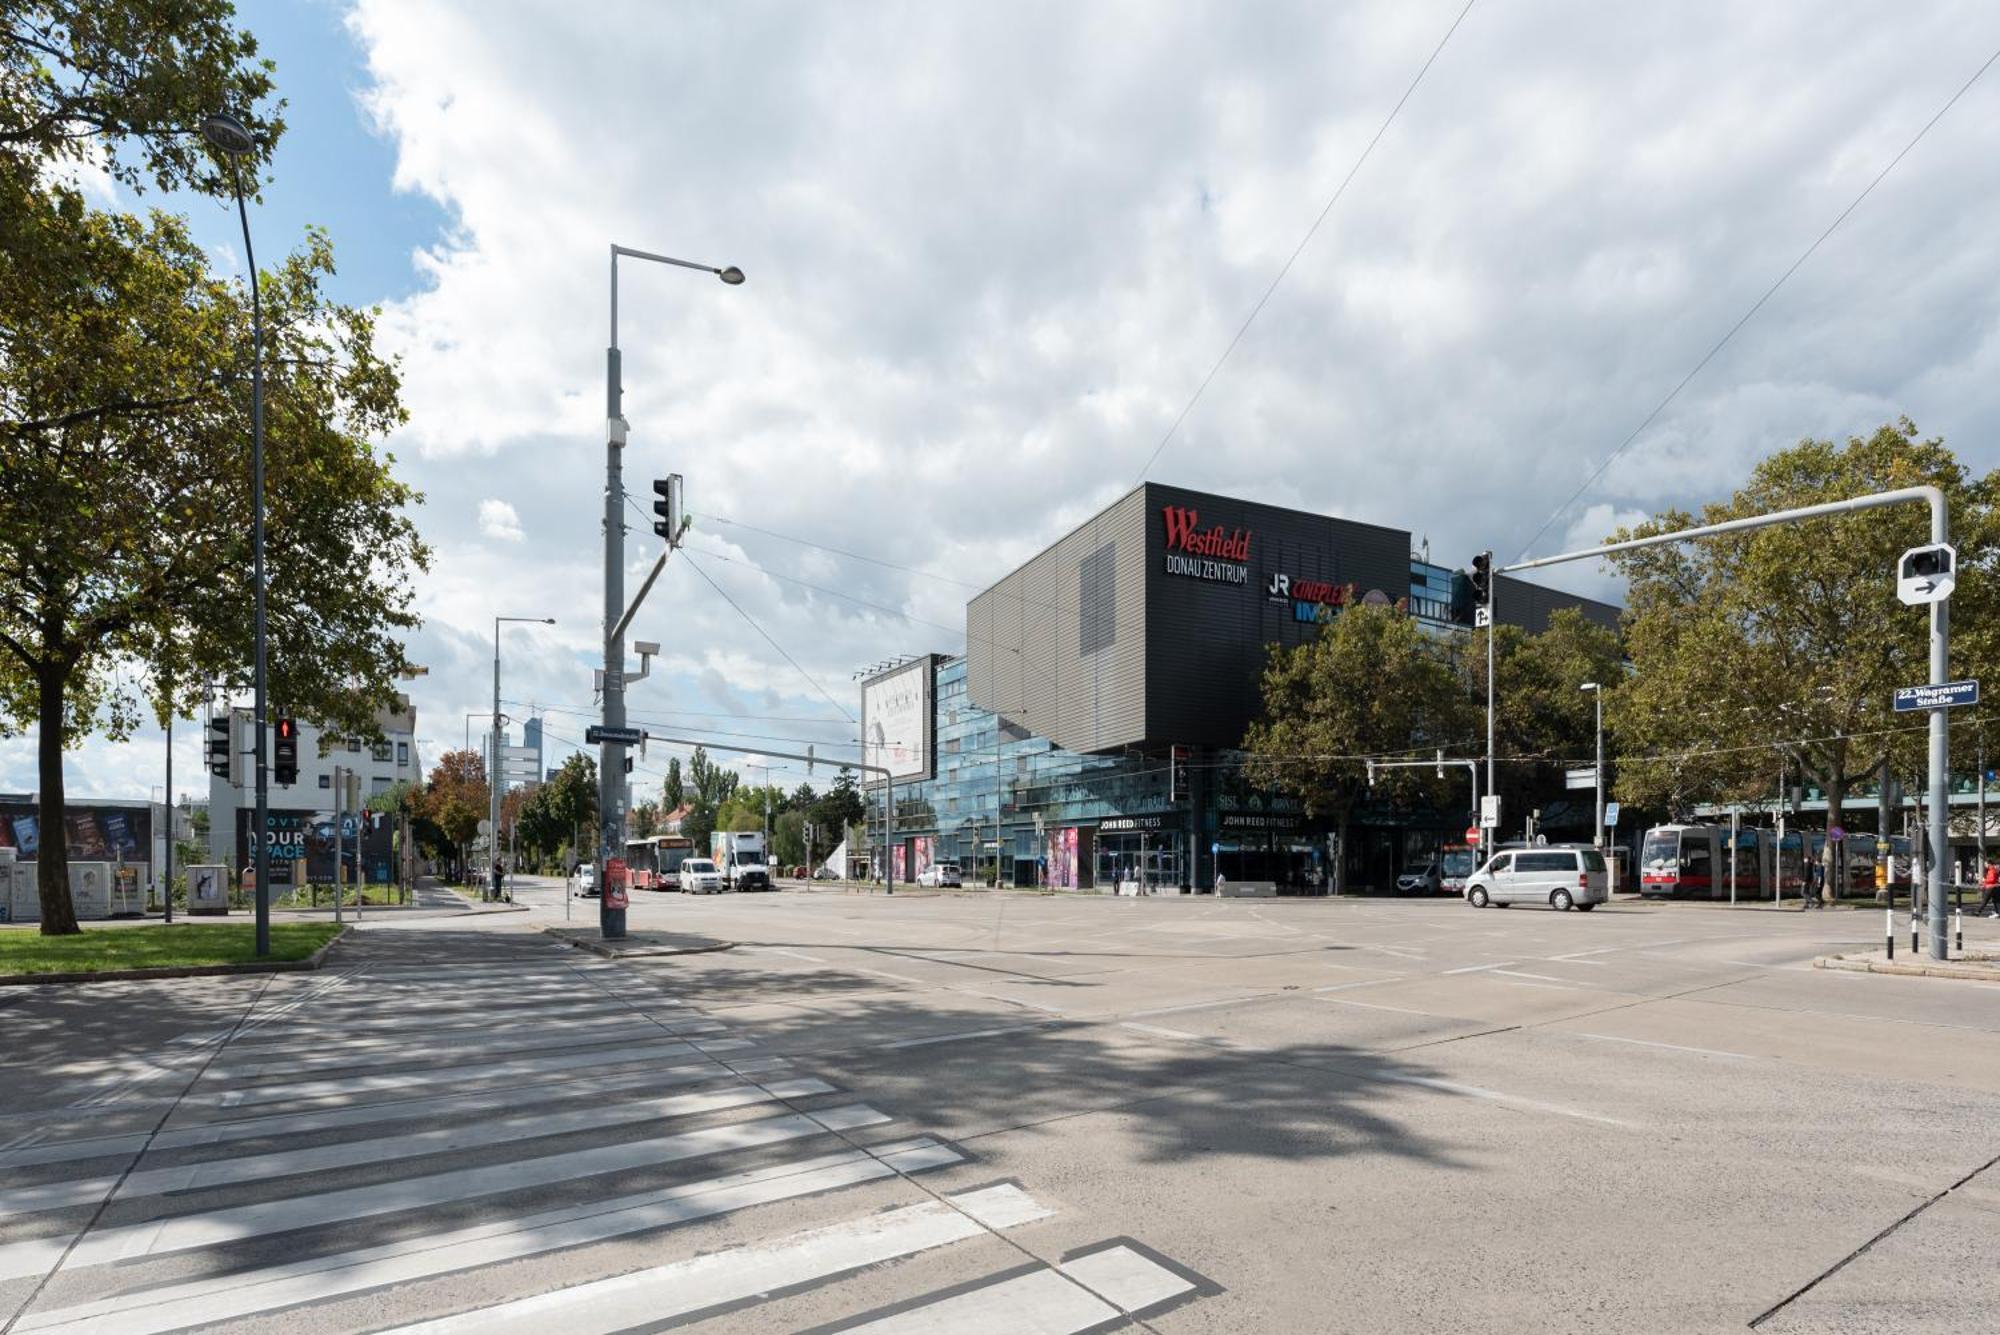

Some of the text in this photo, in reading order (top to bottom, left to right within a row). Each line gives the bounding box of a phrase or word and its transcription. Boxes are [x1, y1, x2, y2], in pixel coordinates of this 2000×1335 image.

[1162, 505, 1251, 561] Westfield
[1167, 554, 1248, 584] DONAU ZENTRUM
[1269, 573, 1289, 596] JR
[1916, 695, 1954, 706] Straße
[1100, 817, 1161, 830] JOHN REED FITNESS
[1224, 816, 1245, 826] JOHN
[1246, 816, 1265, 827] REED
